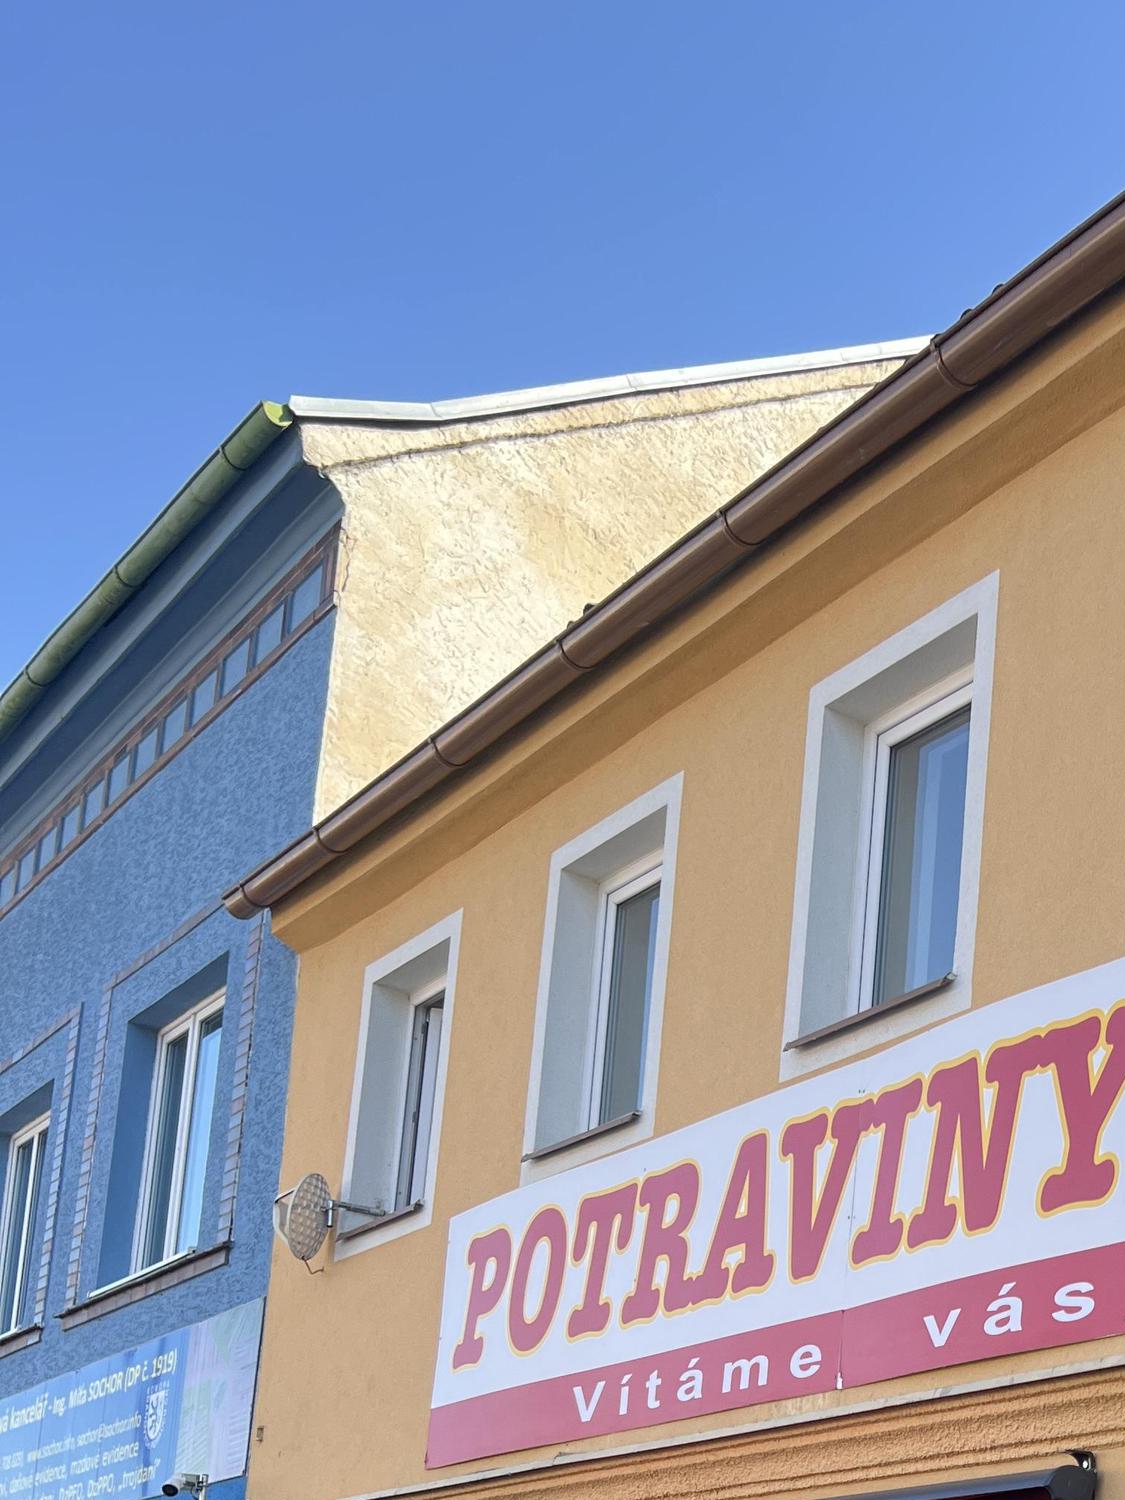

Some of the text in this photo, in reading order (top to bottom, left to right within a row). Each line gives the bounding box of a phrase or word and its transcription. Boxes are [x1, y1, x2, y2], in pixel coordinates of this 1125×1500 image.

[87, 1371, 124, 1402] SOCHOR
[573, 1282, 1096, 1424] Vítáme vás
